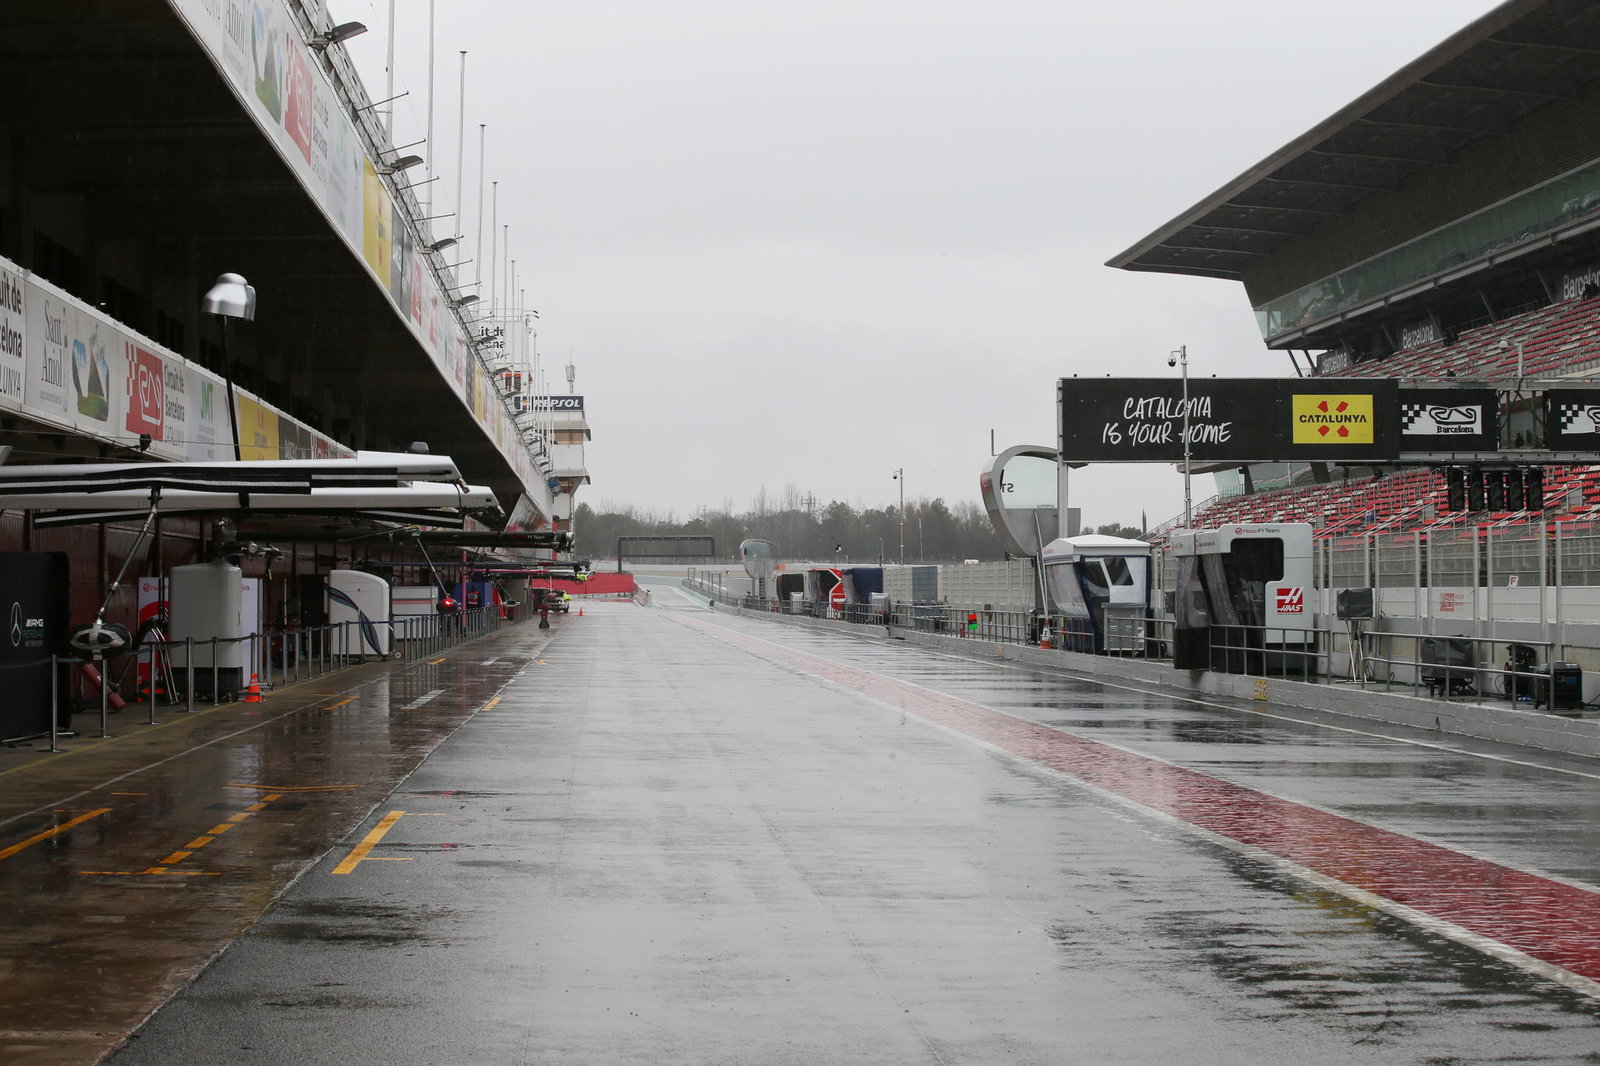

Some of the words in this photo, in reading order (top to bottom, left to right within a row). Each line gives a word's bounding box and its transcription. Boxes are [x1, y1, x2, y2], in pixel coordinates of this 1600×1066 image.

[11, 277, 22, 315] de
[44, 299, 63, 347] Sant
[0, 317, 22, 358] elona
[1402, 325, 1435, 349] Barcelona
[41, 343, 63, 388] Aniol
[164, 393, 185, 422] Barcelona
[200, 379, 214, 424] JMT
[1123, 396, 1212, 419] CATALONIA
[1299, 414, 1367, 423] CATALUNYA
[1436, 425, 1475, 434] Barcelona
[1102, 422, 1122, 445] IS
[1128, 421, 1173, 446] YOUR
[1178, 421, 1232, 445] HOME
[1510, 576, 1517, 585] F
[1276, 604, 1303, 612] HAAS
